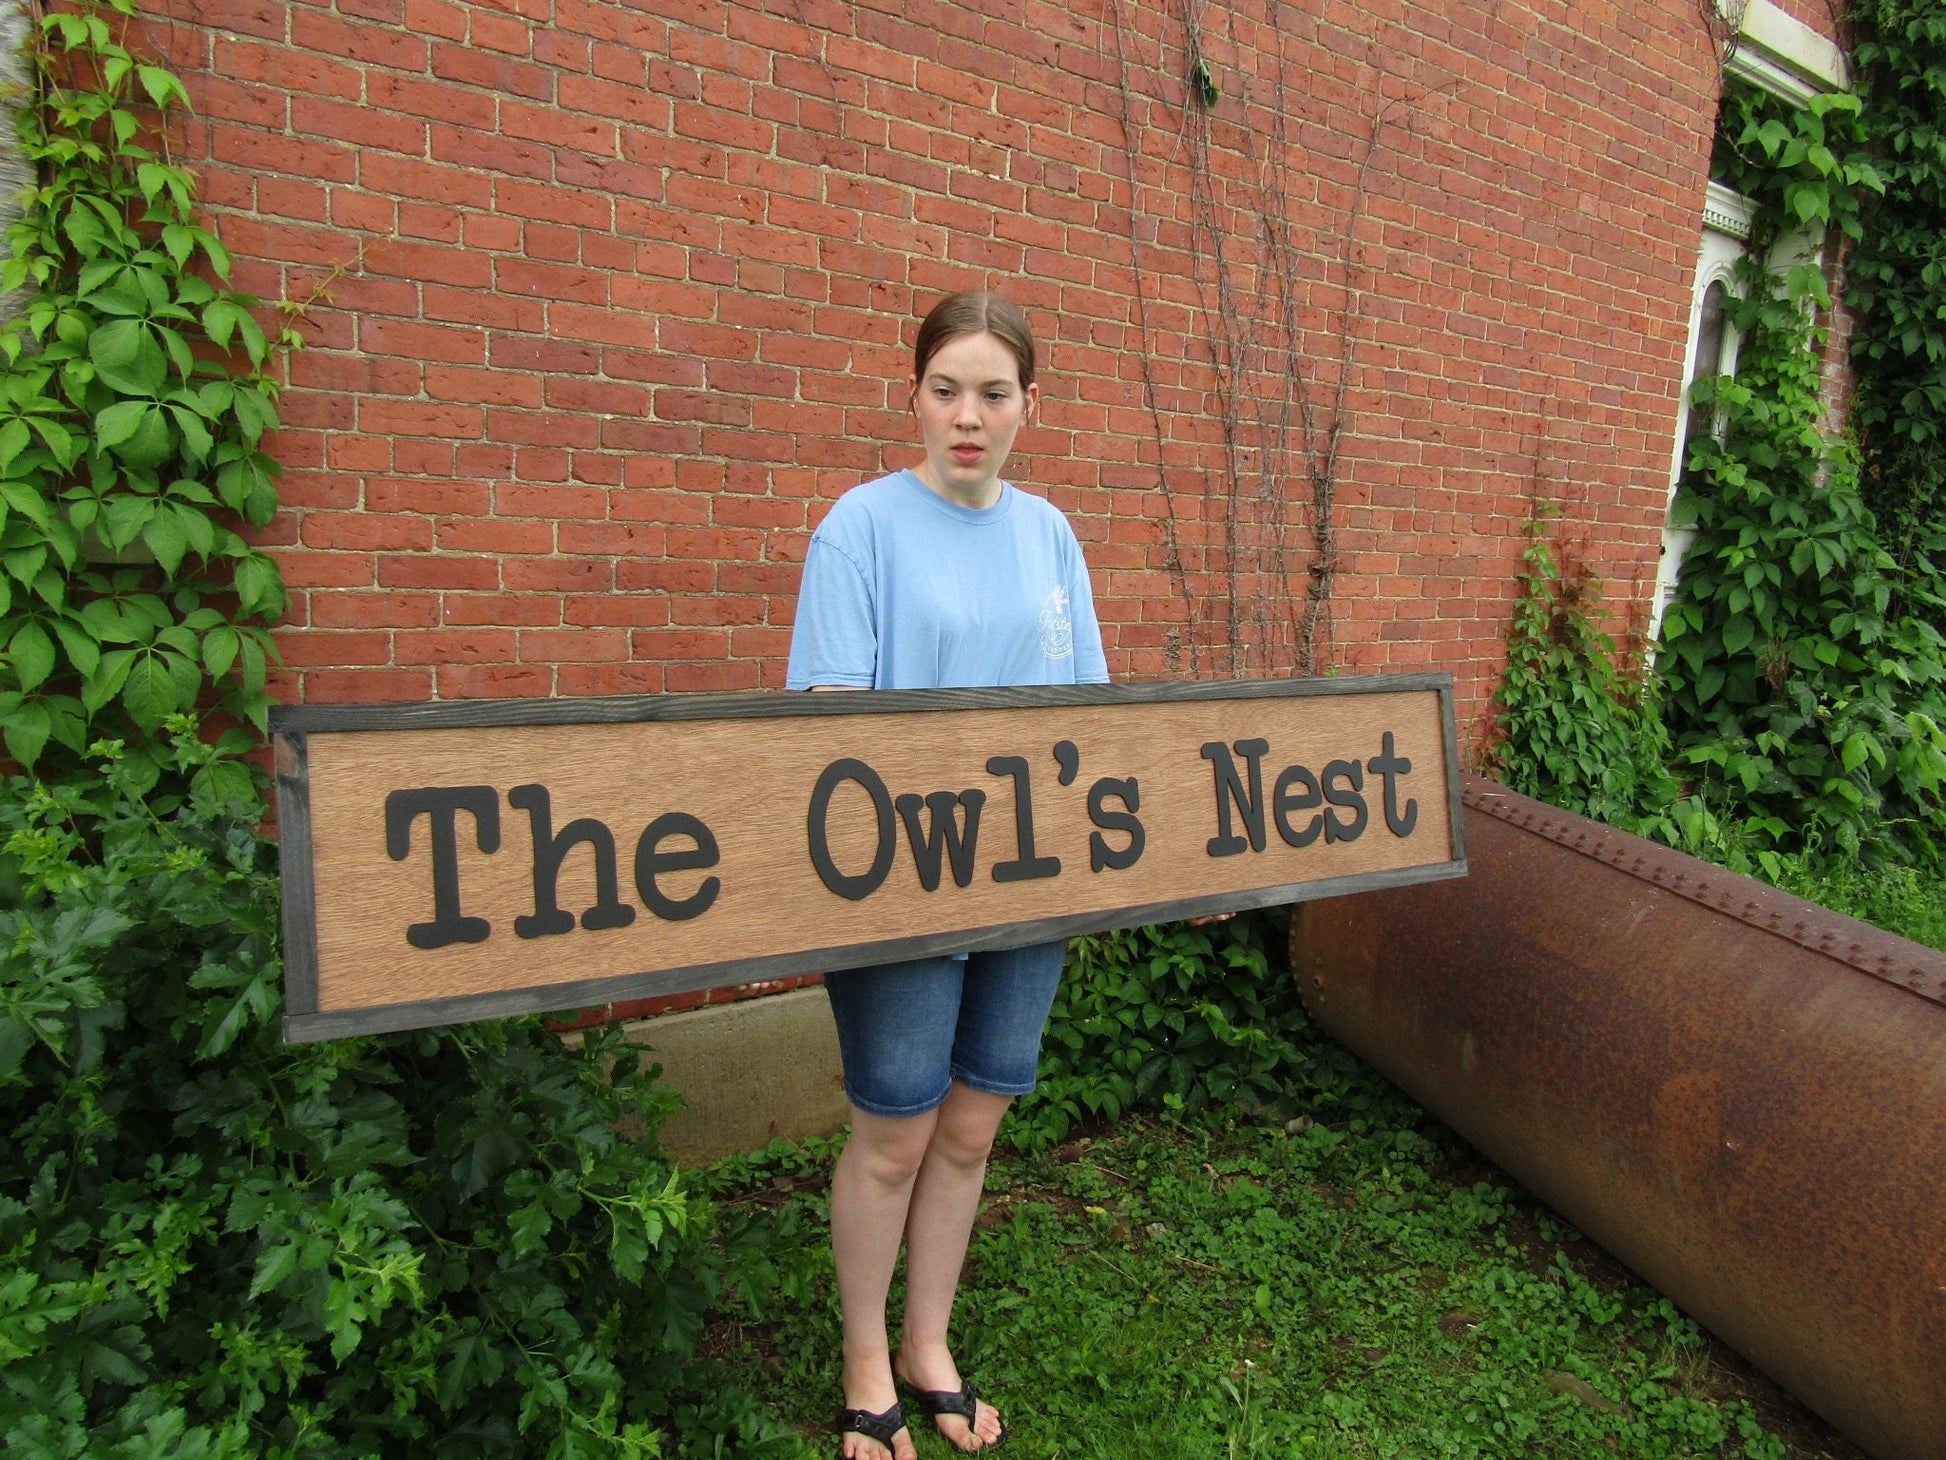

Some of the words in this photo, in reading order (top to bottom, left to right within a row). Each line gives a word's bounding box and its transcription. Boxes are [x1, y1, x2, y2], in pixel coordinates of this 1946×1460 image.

[386, 784, 721, 949] The
[808, 741, 1145, 902] Owl's
[1201, 732, 1418, 857] Nest
